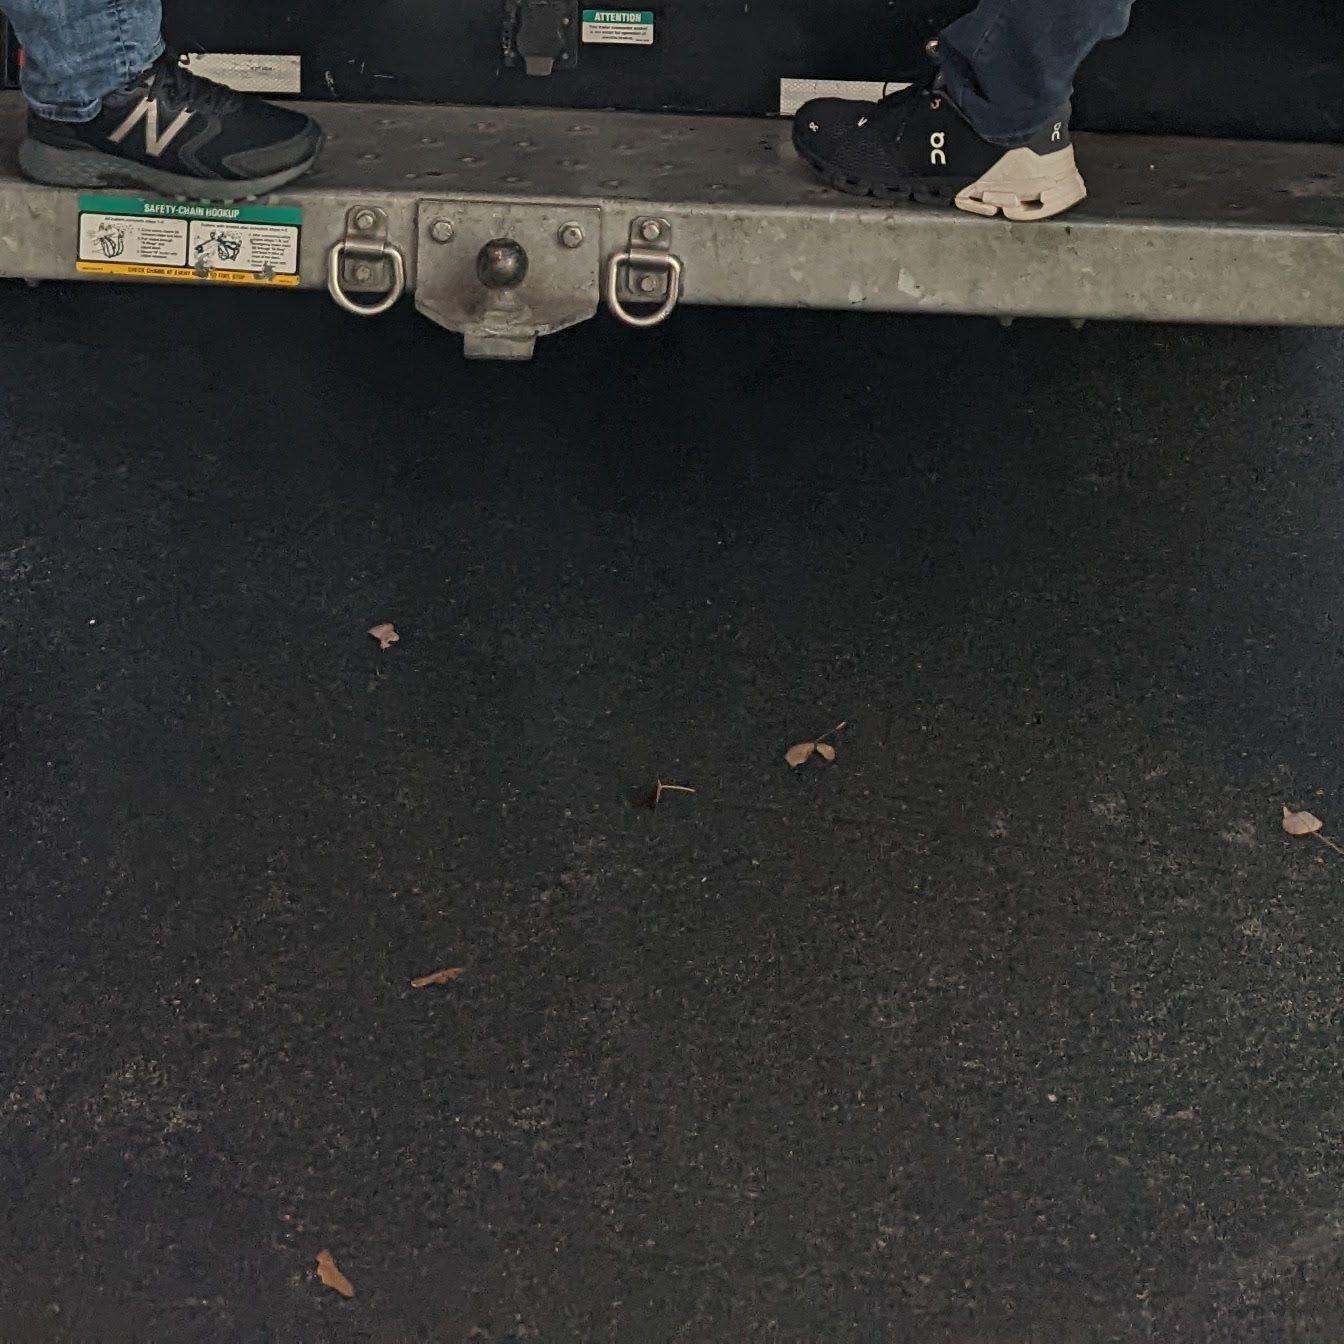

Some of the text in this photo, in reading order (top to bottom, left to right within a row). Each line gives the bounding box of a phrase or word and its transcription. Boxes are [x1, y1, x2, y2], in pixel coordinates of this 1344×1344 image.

[594, 11, 642, 23] ATTENTION
[143, 203, 240, 219] SAFETY-CHAIN HOOKUP
